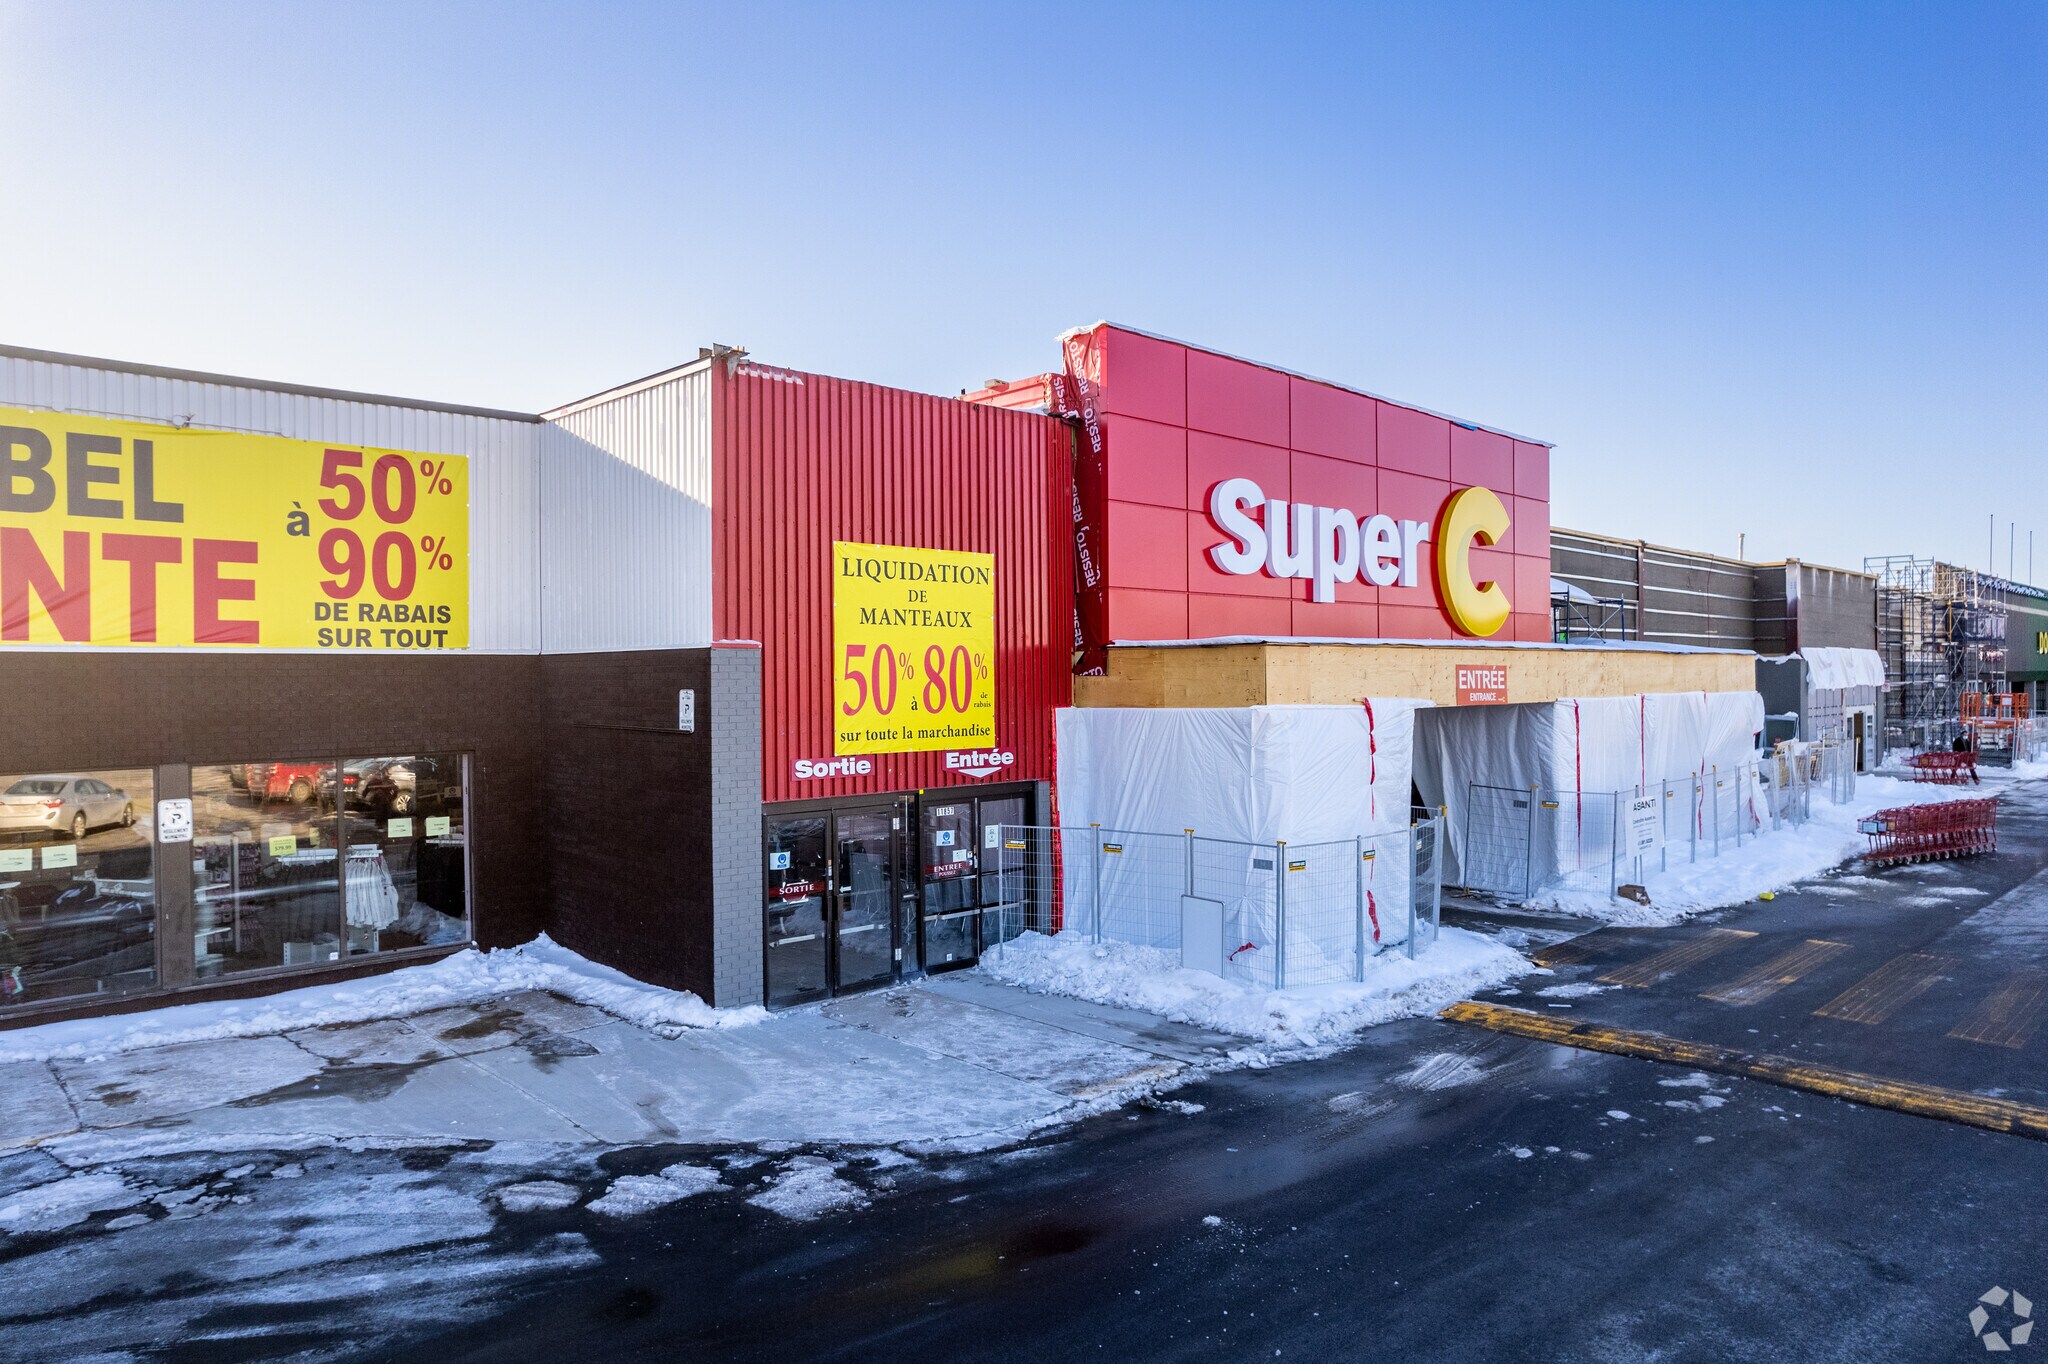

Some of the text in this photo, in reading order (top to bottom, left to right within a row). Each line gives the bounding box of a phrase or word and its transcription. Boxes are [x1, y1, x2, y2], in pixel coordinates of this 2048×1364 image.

[0, 425, 184, 523] BEL
[286, 501, 311, 537] à
[1076, 531, 1096, 588] RESISTO
[1209, 477, 1512, 637] Super C
[842, 557, 990, 585] LIQUIDATION
[0, 527, 260, 644] NTE
[908, 589, 928, 603] DE
[314, 602, 452, 624] DE RABAIS
[859, 607, 972, 628] MANTEAUX
[317, 628, 449, 648] SUR TOUT
[1459, 665, 1505, 689] ENTRÉE
[911, 696, 918, 711] à
[1470, 692, 1497, 702] ENTRANCE
[840, 723, 991, 742] sur toute la marchandise
[794, 757, 872, 779] Sortie
[946, 749, 1015, 769] Entrée
[779, 883, 814, 895] SORTIE
